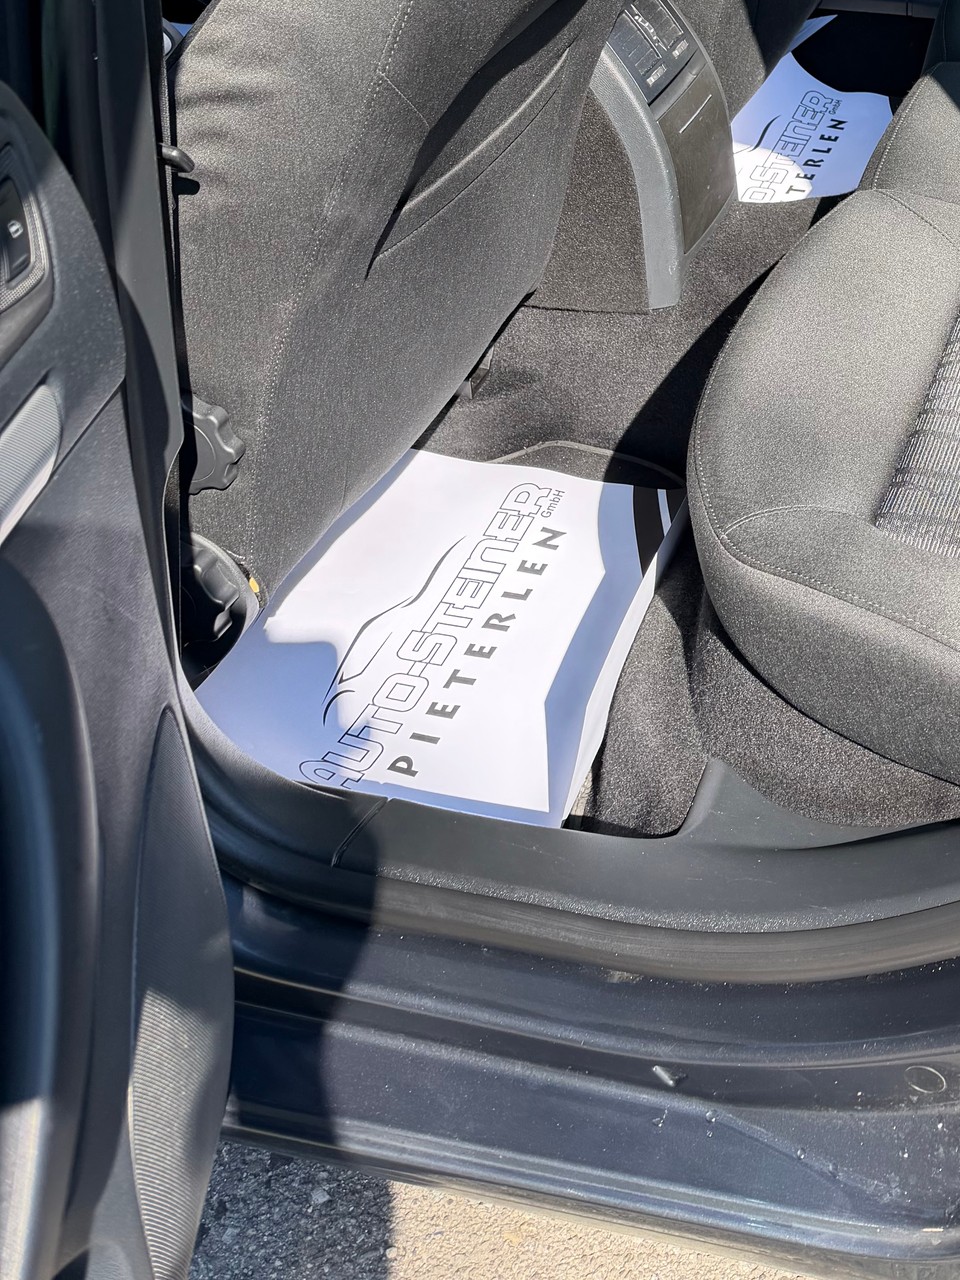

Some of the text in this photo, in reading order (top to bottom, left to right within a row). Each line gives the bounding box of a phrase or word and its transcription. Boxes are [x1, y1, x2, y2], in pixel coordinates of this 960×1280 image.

[740, 90, 833, 201] O-STEINER
[785, 118, 848, 194] TERLEN
[540, 489, 566, 518] GmbH
[386, 526, 567, 778] PIETERLEN
